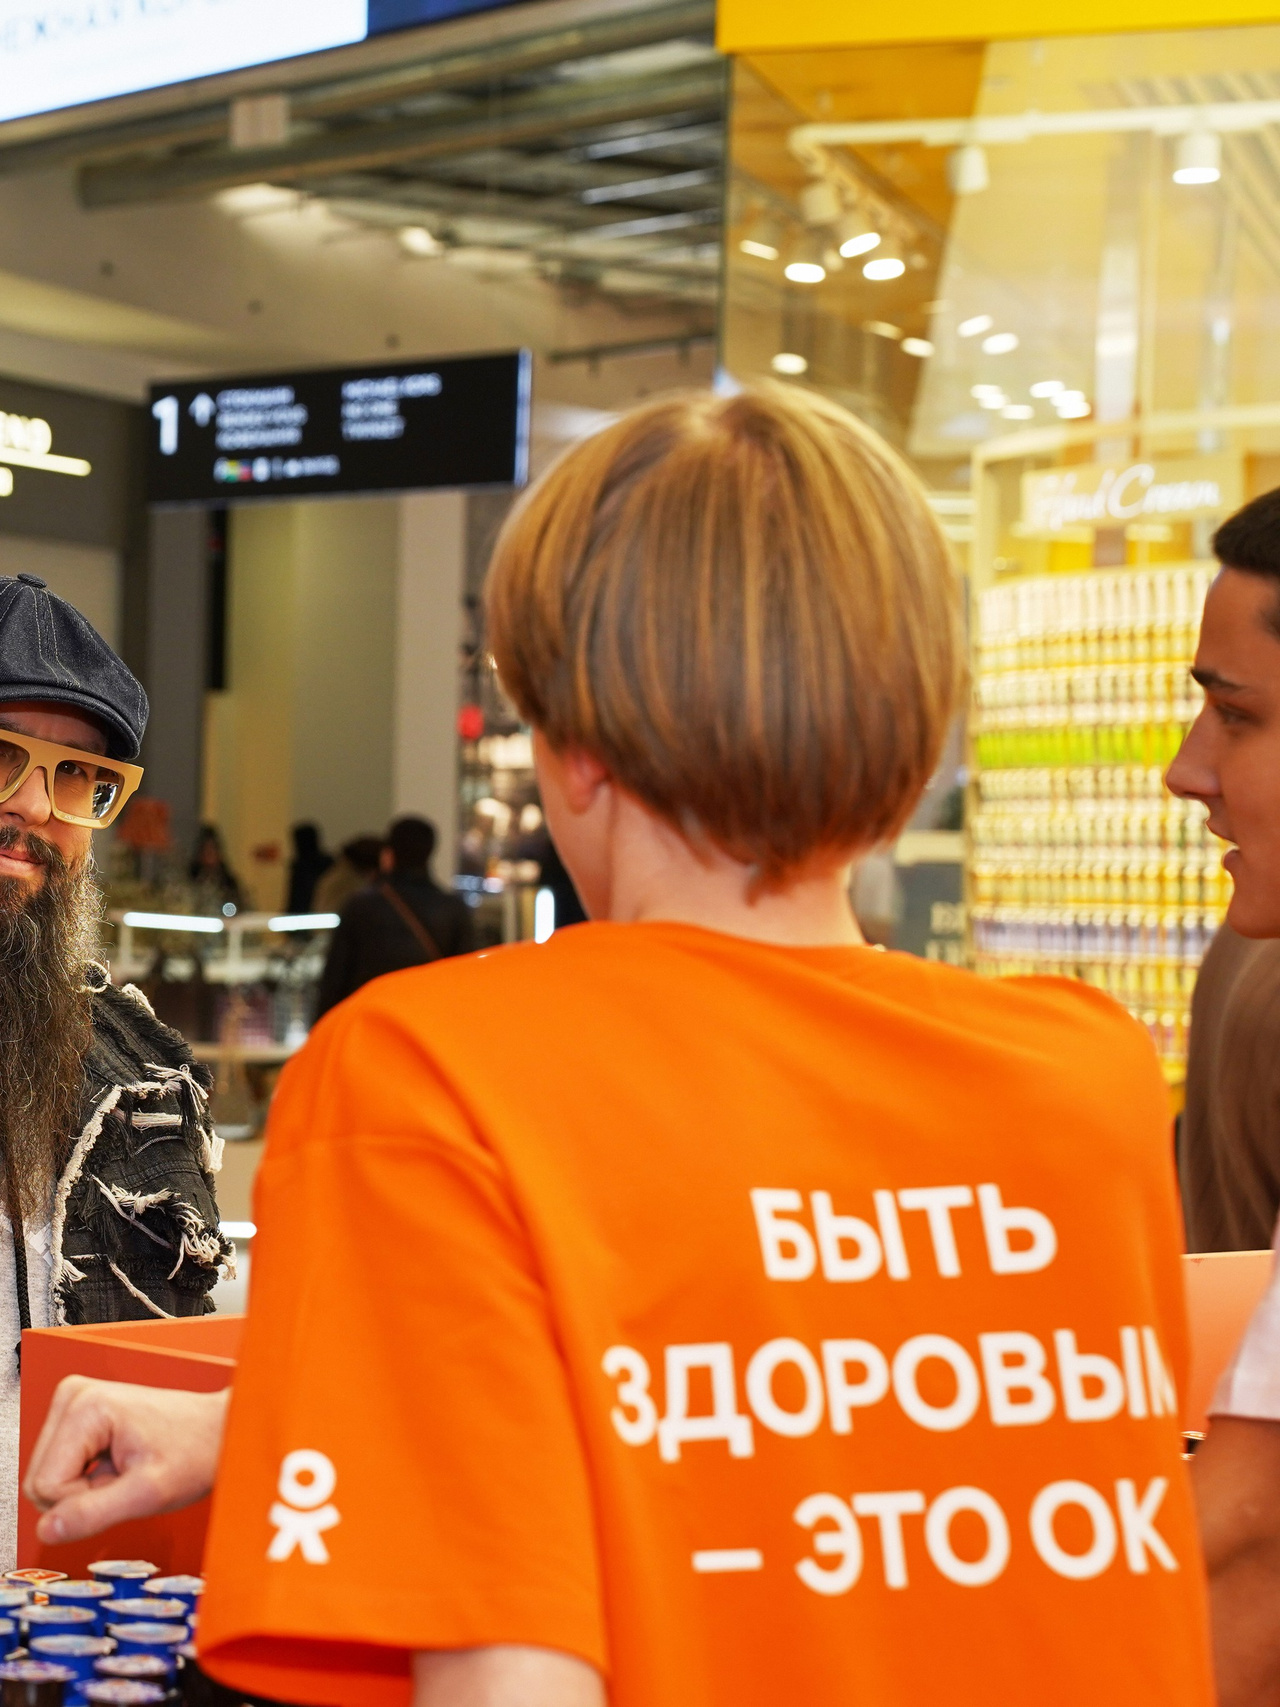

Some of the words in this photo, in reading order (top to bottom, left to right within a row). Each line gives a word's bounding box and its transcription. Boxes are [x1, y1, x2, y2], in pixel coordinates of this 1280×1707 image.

[152, 395, 179, 456] 1
[750, 1183, 1057, 1282] БЫТЬ
[794, 1486, 1010, 1595] ЭТО
